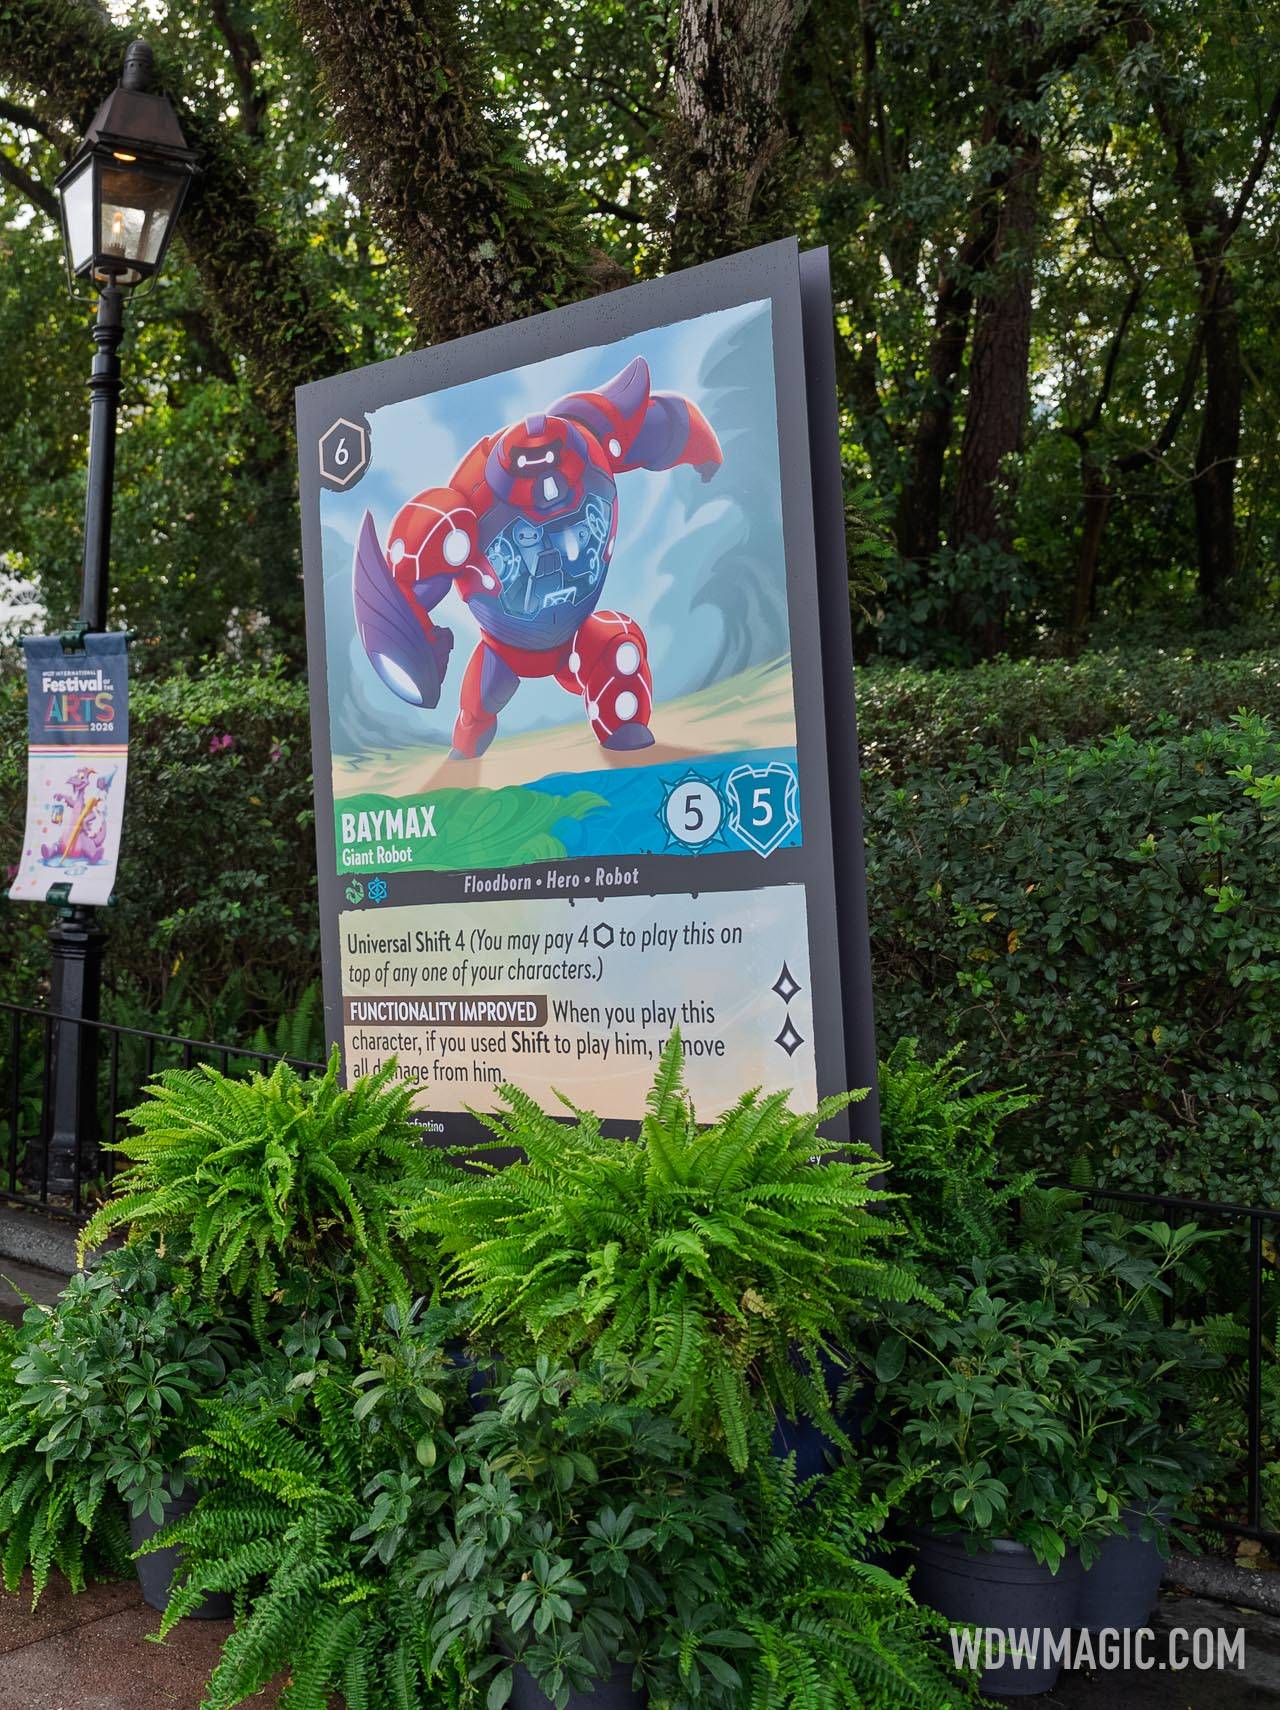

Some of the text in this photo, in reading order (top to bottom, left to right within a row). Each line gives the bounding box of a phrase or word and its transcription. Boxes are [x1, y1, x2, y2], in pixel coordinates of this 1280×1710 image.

[334, 437, 349, 466] 6
[42, 669, 102, 693] Festival
[44, 692, 115, 722] ARTS
[90, 722, 114, 732] 2026
[683, 794, 704, 831] 5
[751, 788, 773, 827] 5
[341, 805, 437, 844] BAYMAX
[342, 844, 413, 866] Giant Robot
[463, 867, 639, 894] Floodborn Hero Robot
[347, 921, 742, 955] Universal Shift 4 (You may pay 4 to play this on
[349, 956, 604, 988] top of any one of your characters.)
[350, 999, 715, 1029] FUNCTIONALITY IMPROVED When you play this
[351, 1029, 725, 1060] character, if you used Shift to play him, rmove
[353, 1057, 507, 1085] all dmage from him.
